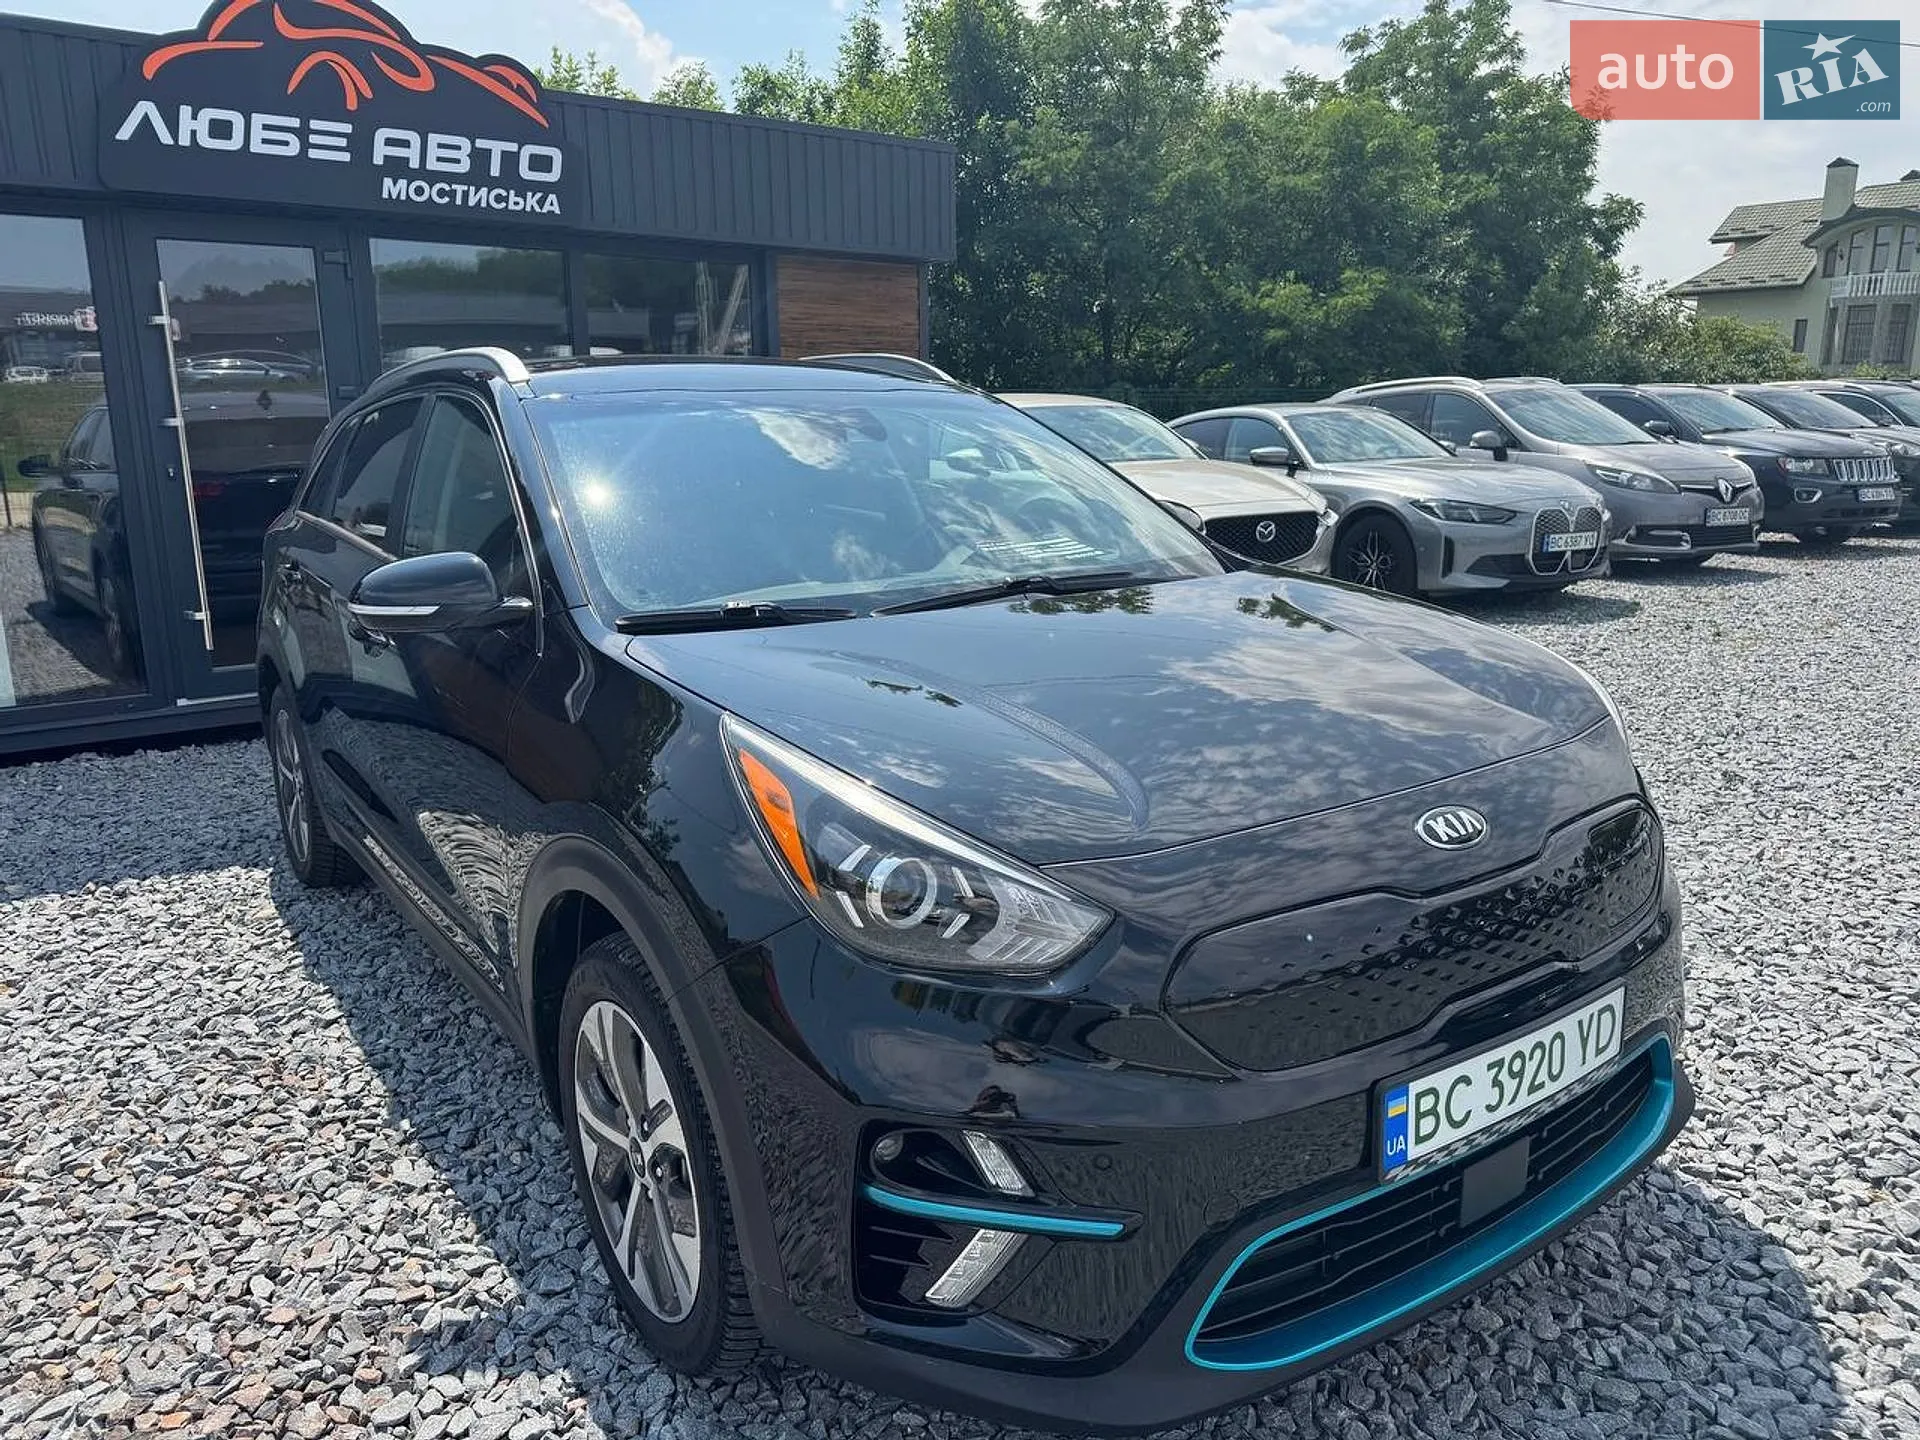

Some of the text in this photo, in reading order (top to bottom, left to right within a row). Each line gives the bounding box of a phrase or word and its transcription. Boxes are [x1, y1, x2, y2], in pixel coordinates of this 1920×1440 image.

[115, 100, 563, 182] ЛЮБЕ АВТО
[381, 177, 561, 214] МОСТИСЬКА
[1549, 536, 1562, 549] BC
[1426, 811, 1482, 841] KIA
[1414, 1003, 1616, 1146] BC 3920 YD
[1387, 1135, 1406, 1155] UA
